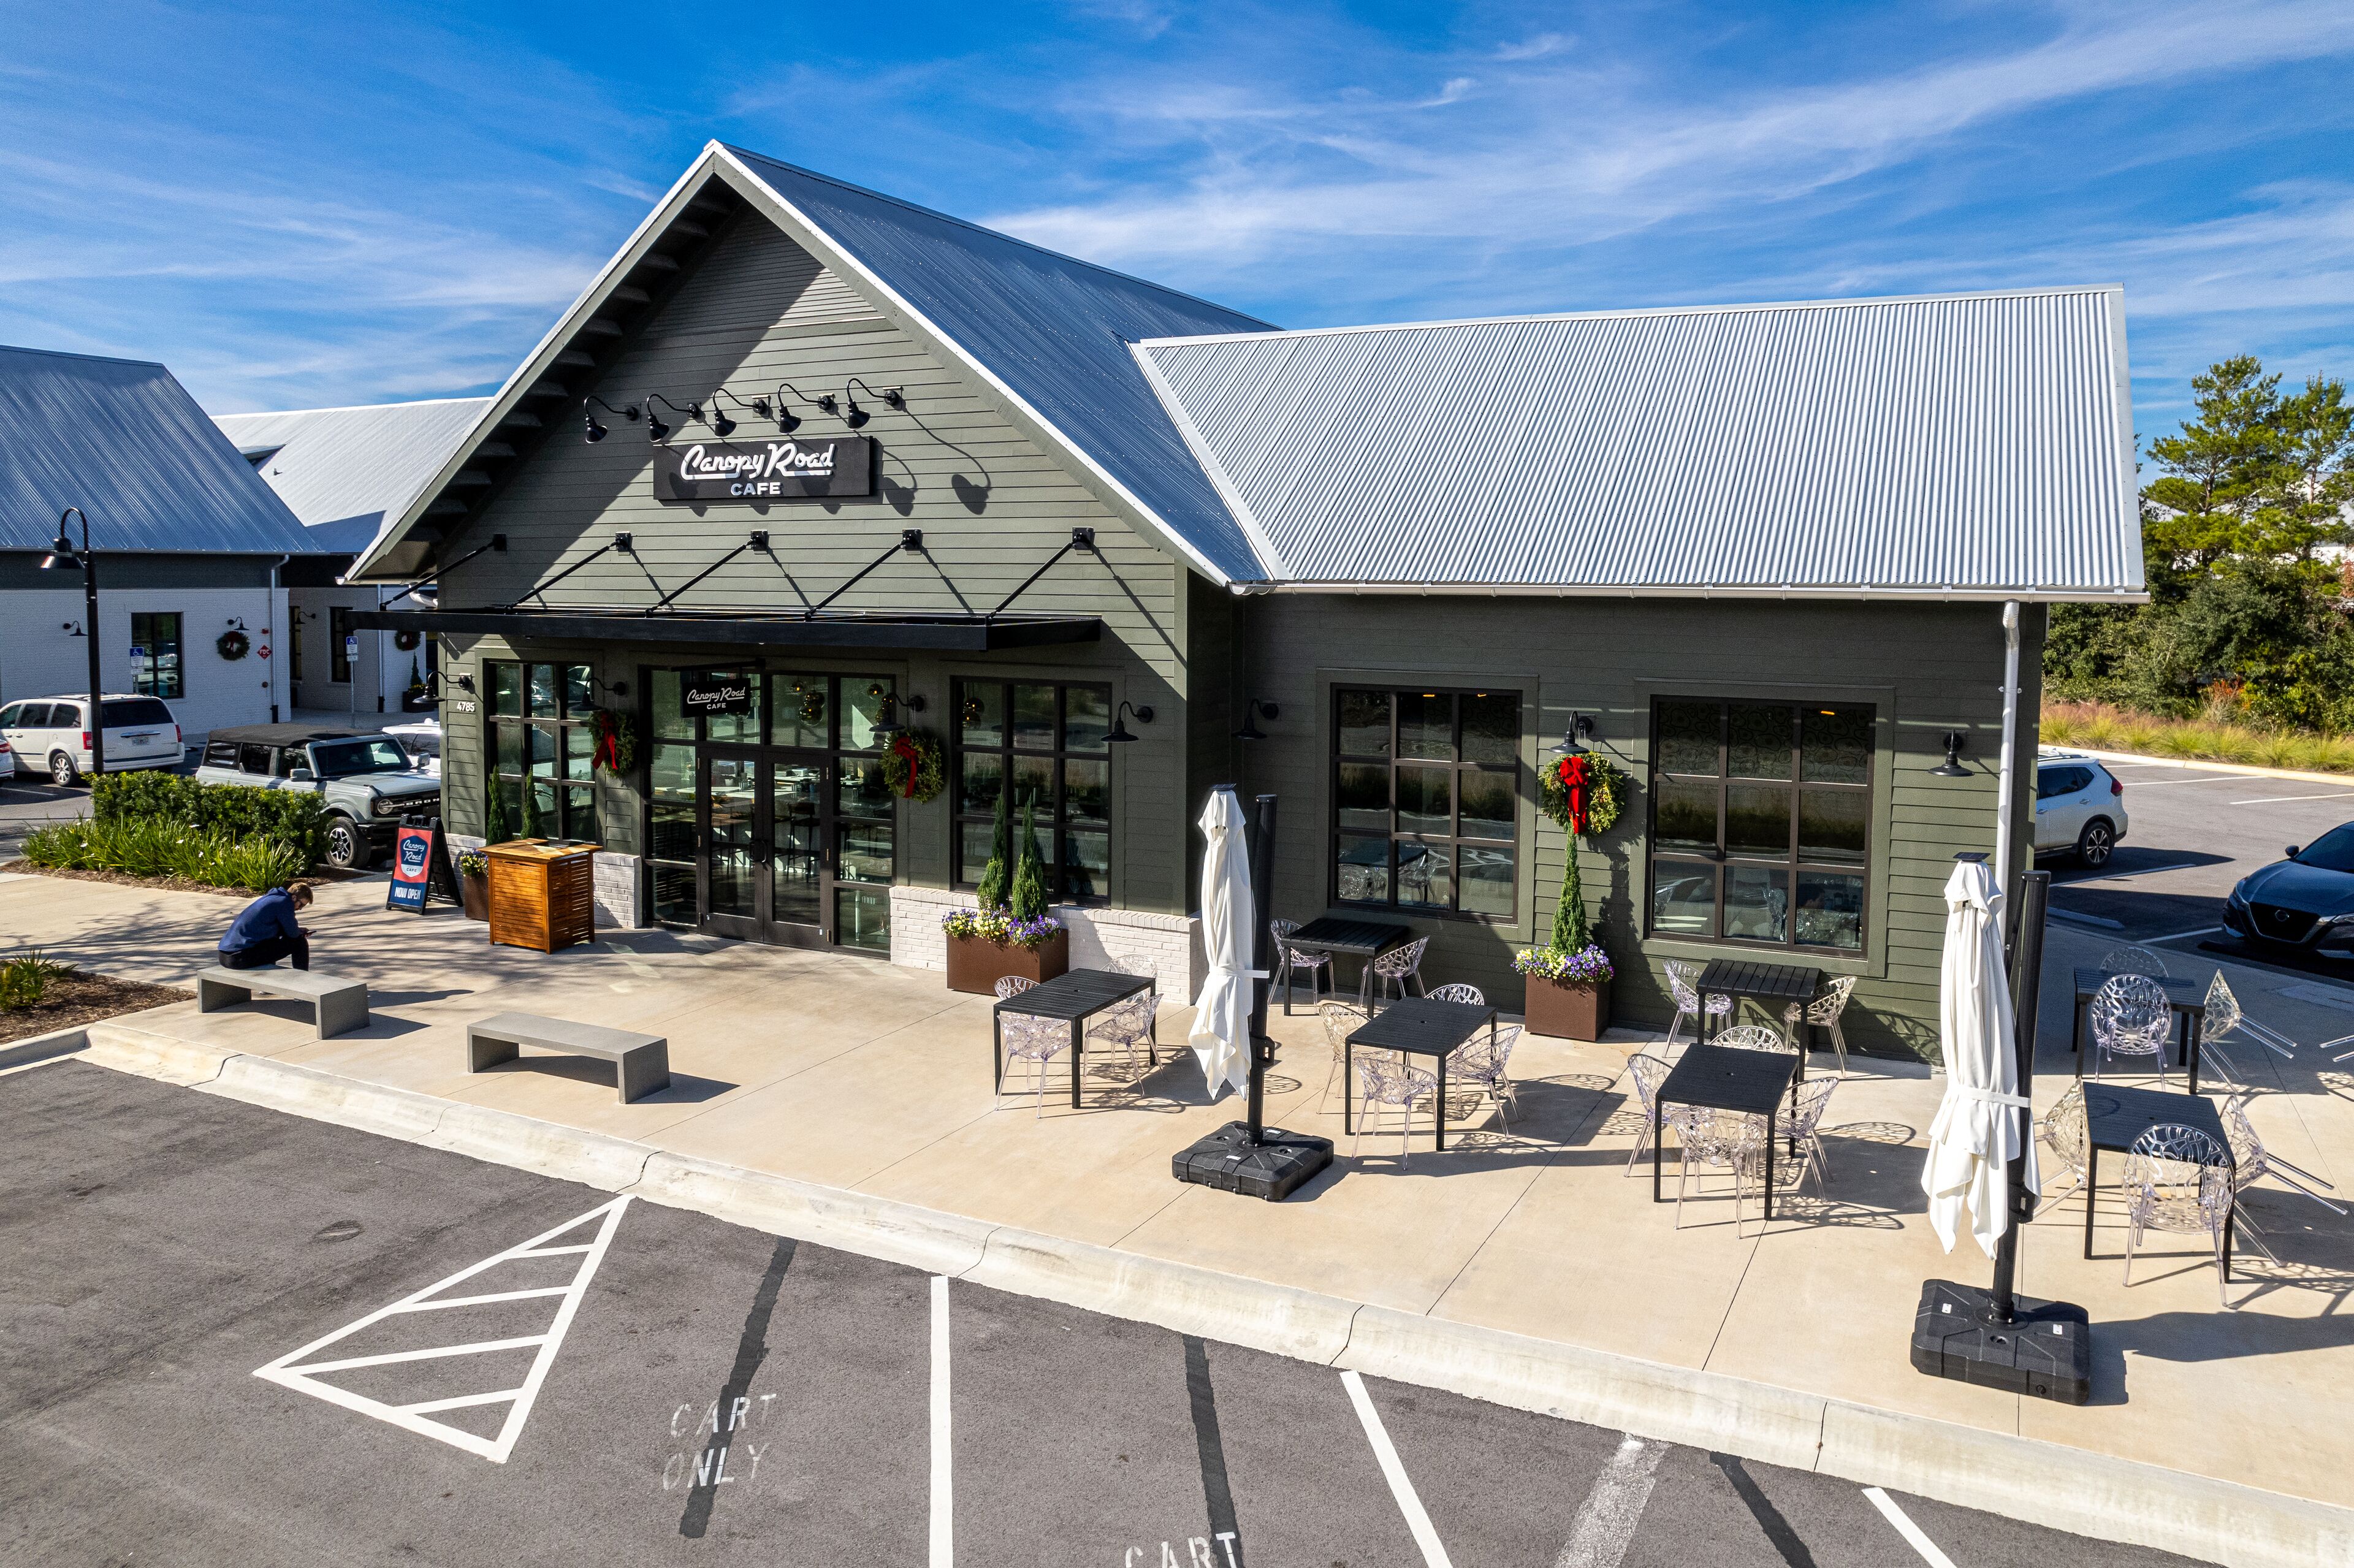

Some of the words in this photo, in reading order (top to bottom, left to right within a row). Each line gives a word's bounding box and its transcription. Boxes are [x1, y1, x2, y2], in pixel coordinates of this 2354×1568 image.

[680, 444, 765, 481] Canopy
[764, 443, 836, 478] Road
[730, 481, 782, 496] CAFE
[687, 689, 720, 704] Canopy
[720, 687, 746, 701] Road
[456, 701, 476, 712] 4785
[403, 839, 425, 852] Canopy
[404, 851, 422, 863] Road
[394, 886, 408, 899] NOW
[408, 888, 421, 900] OPEN
[671, 1393, 777, 1437] CART
[663, 1443, 769, 1490] ONLY
